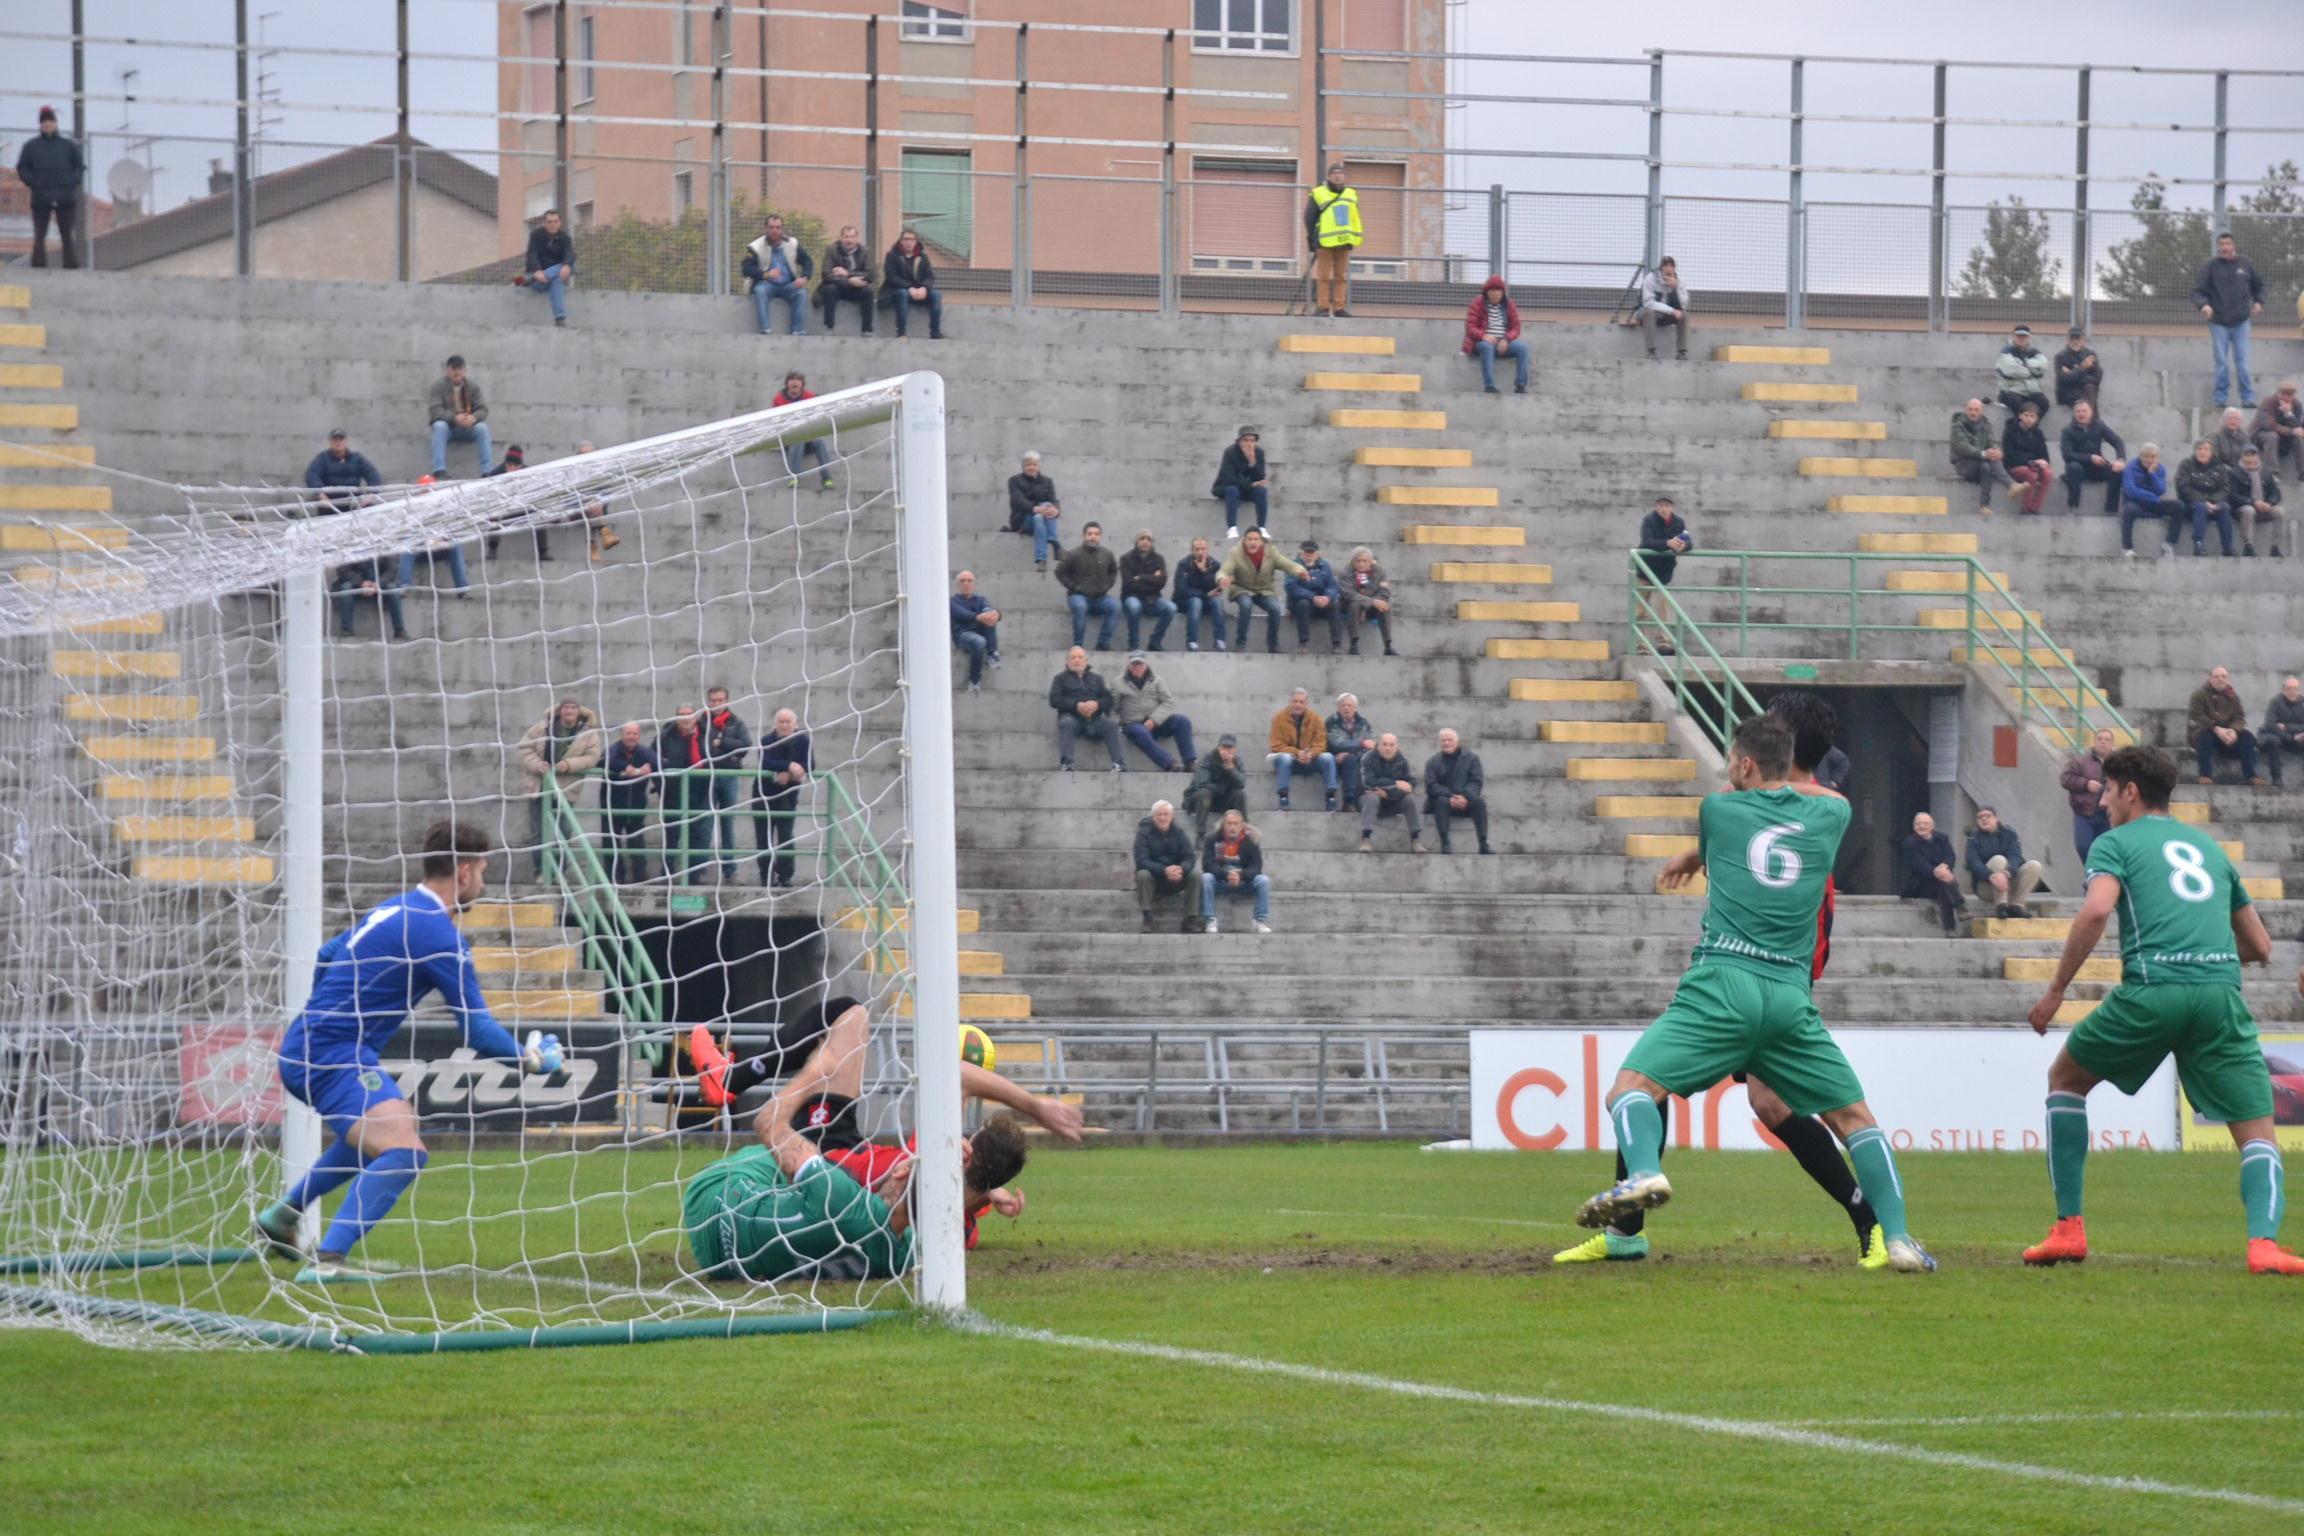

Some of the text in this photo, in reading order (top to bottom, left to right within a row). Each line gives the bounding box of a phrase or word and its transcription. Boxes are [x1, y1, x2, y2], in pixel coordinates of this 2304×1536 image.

[1746, 822, 1805, 888] 6
[2162, 839, 2215, 903] 8
[1930, 1129, 2006, 1151] STILE
